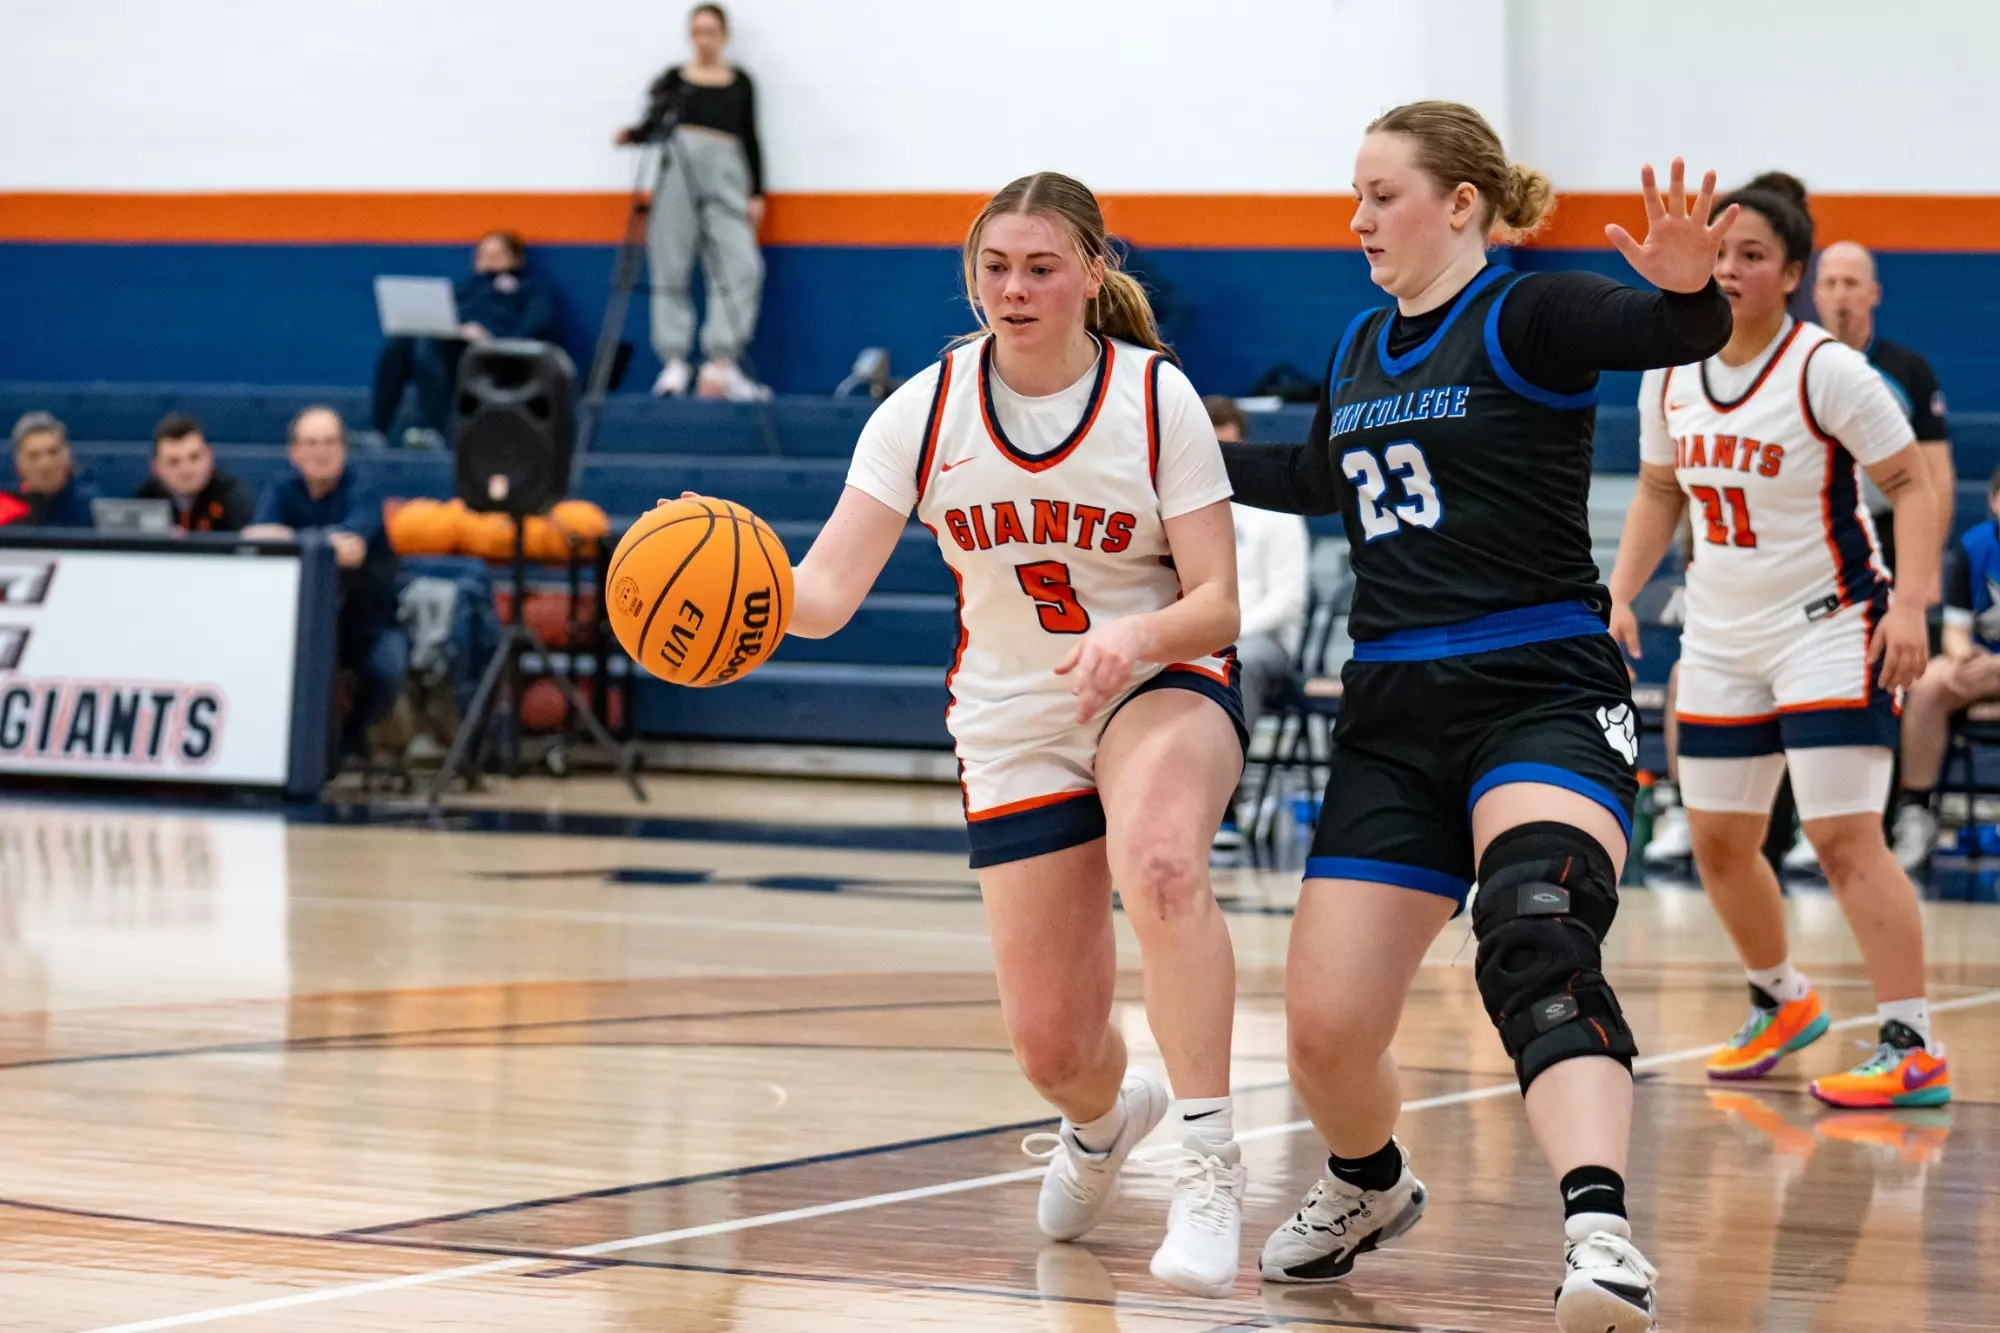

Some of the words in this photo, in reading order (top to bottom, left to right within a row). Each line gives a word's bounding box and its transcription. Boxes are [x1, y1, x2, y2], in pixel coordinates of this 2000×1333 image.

[1363, 385, 1470, 429] COLLEGE
[944, 499, 1137, 553] GIANTS
[1340, 438, 1444, 546] 23
[1014, 560, 1091, 634] 5
[0, 684, 222, 764] GIANTS
